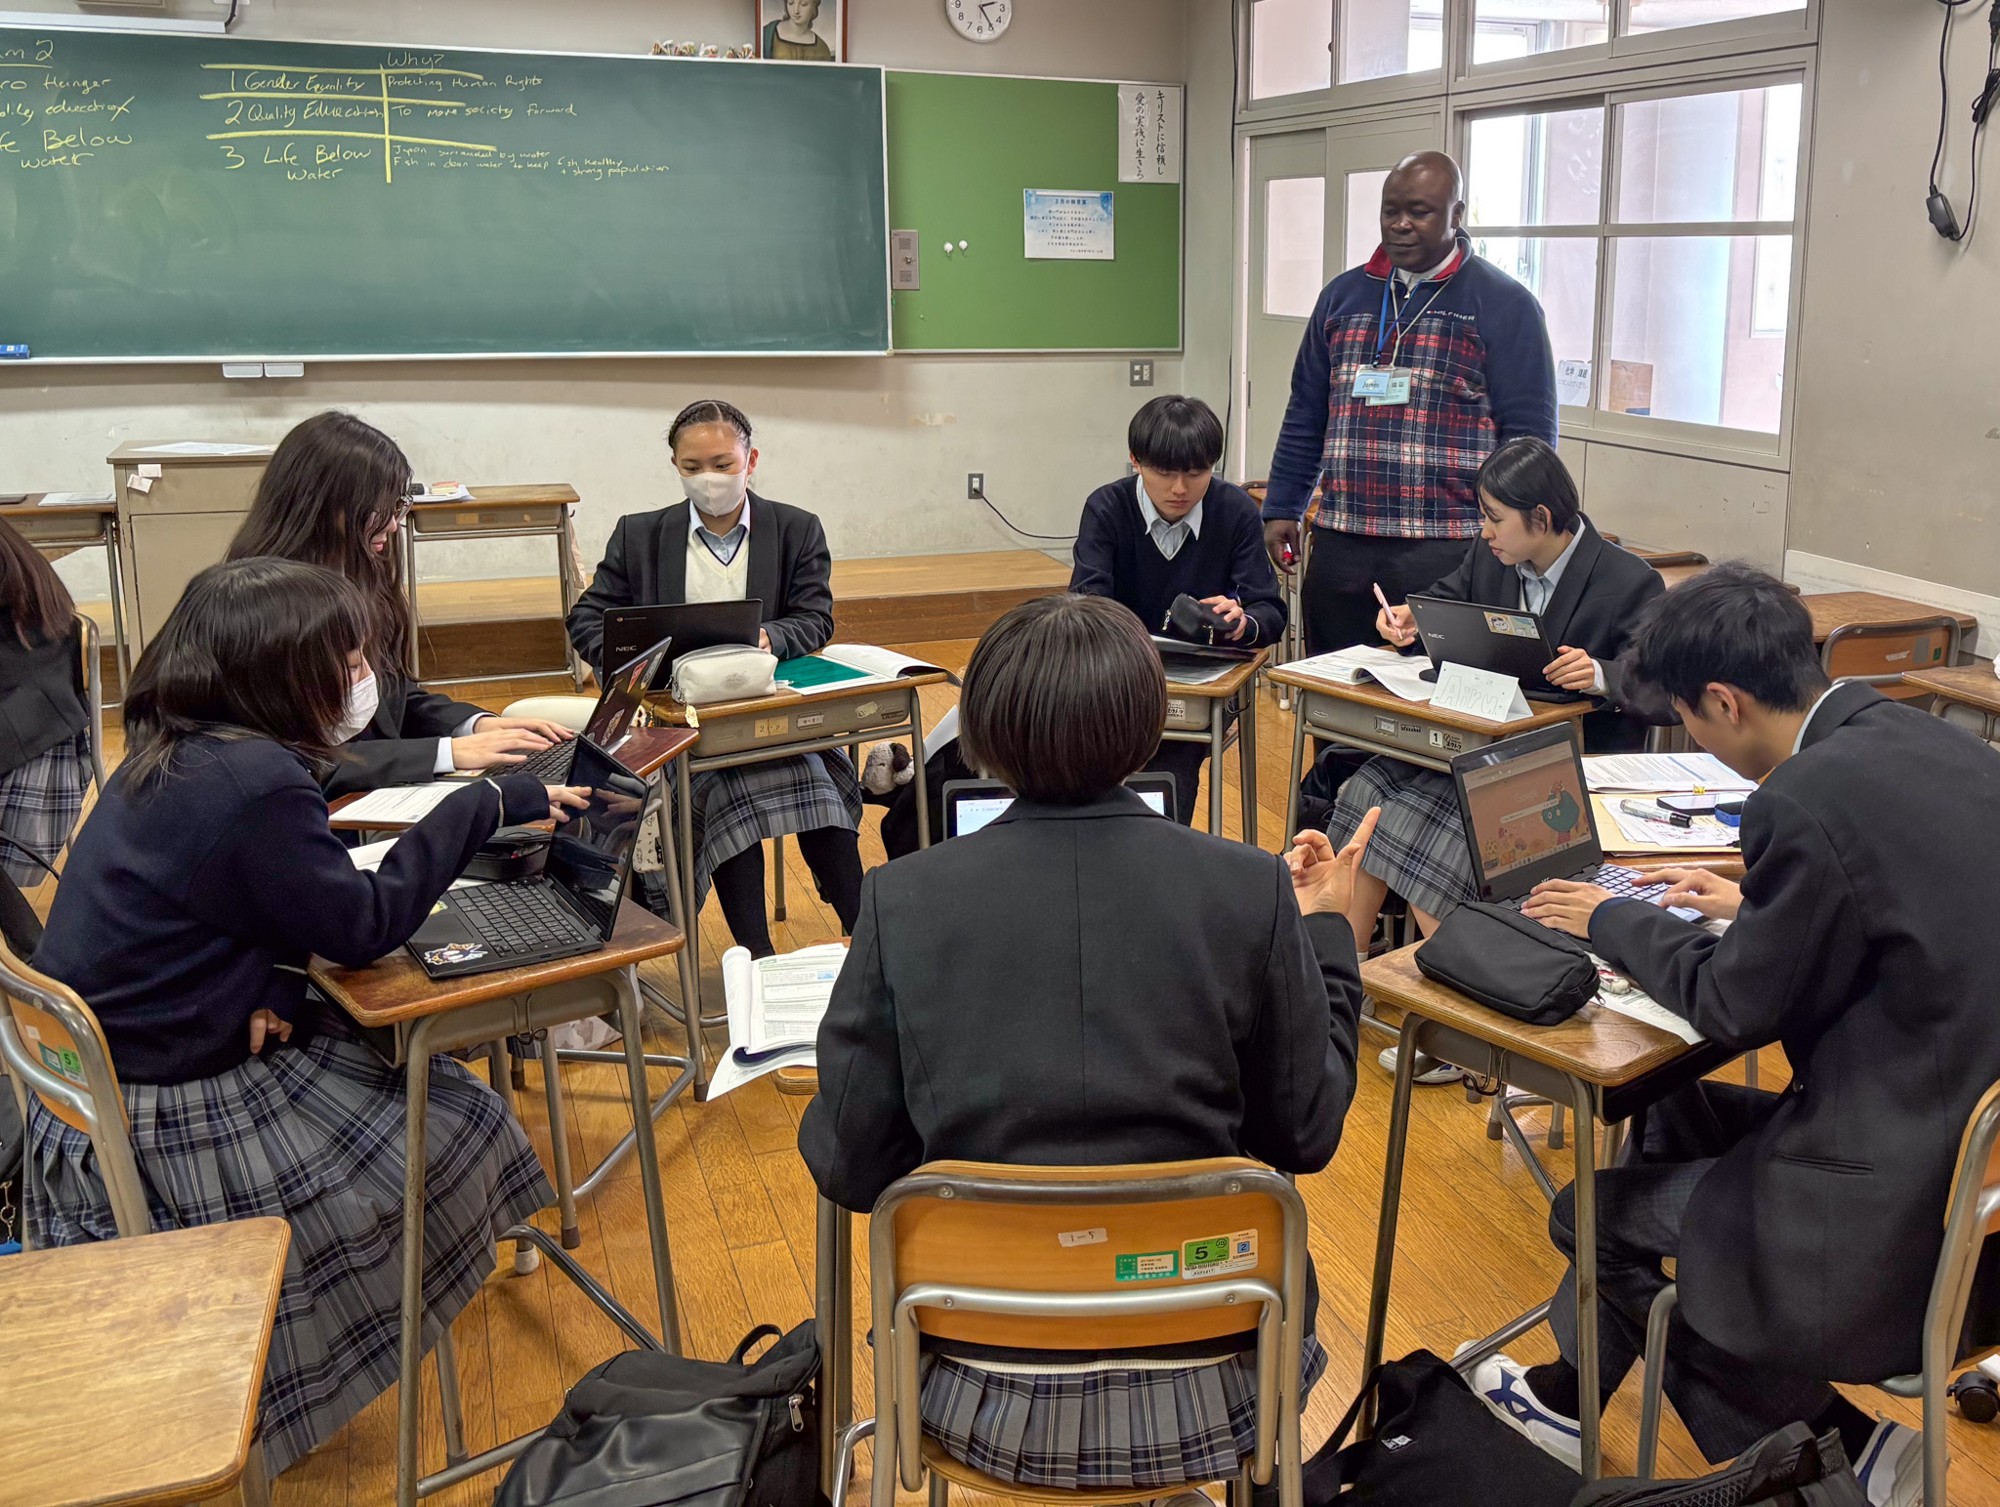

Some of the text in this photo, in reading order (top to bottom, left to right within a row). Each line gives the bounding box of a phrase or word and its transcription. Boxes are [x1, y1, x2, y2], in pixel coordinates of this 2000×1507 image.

[1000, 4, 1006, 12] 3
[959, 12, 964, 20] 8
[967, 21, 973, 30] 7
[977, 26, 983, 34] 6
[36, 40, 54, 61] 2
[387, 52, 445, 76] Why?
[231, 70, 235, 91] 1
[244, 71, 300, 91] Gender
[388, 75, 543, 91] Protecting Human Rights
[225, 100, 244, 125] 2
[248, 104, 296, 128] Quality
[44, 127, 133, 153] Below
[1156, 90, 1166, 175] キリストに信頼し
[219, 142, 372, 169] 3 Life Below
[500, 152, 515, 163] by
[608, 164, 670, 178] population
[1427, 632, 1445, 640] NEC
[1195, 1246, 1208, 1260] 5
